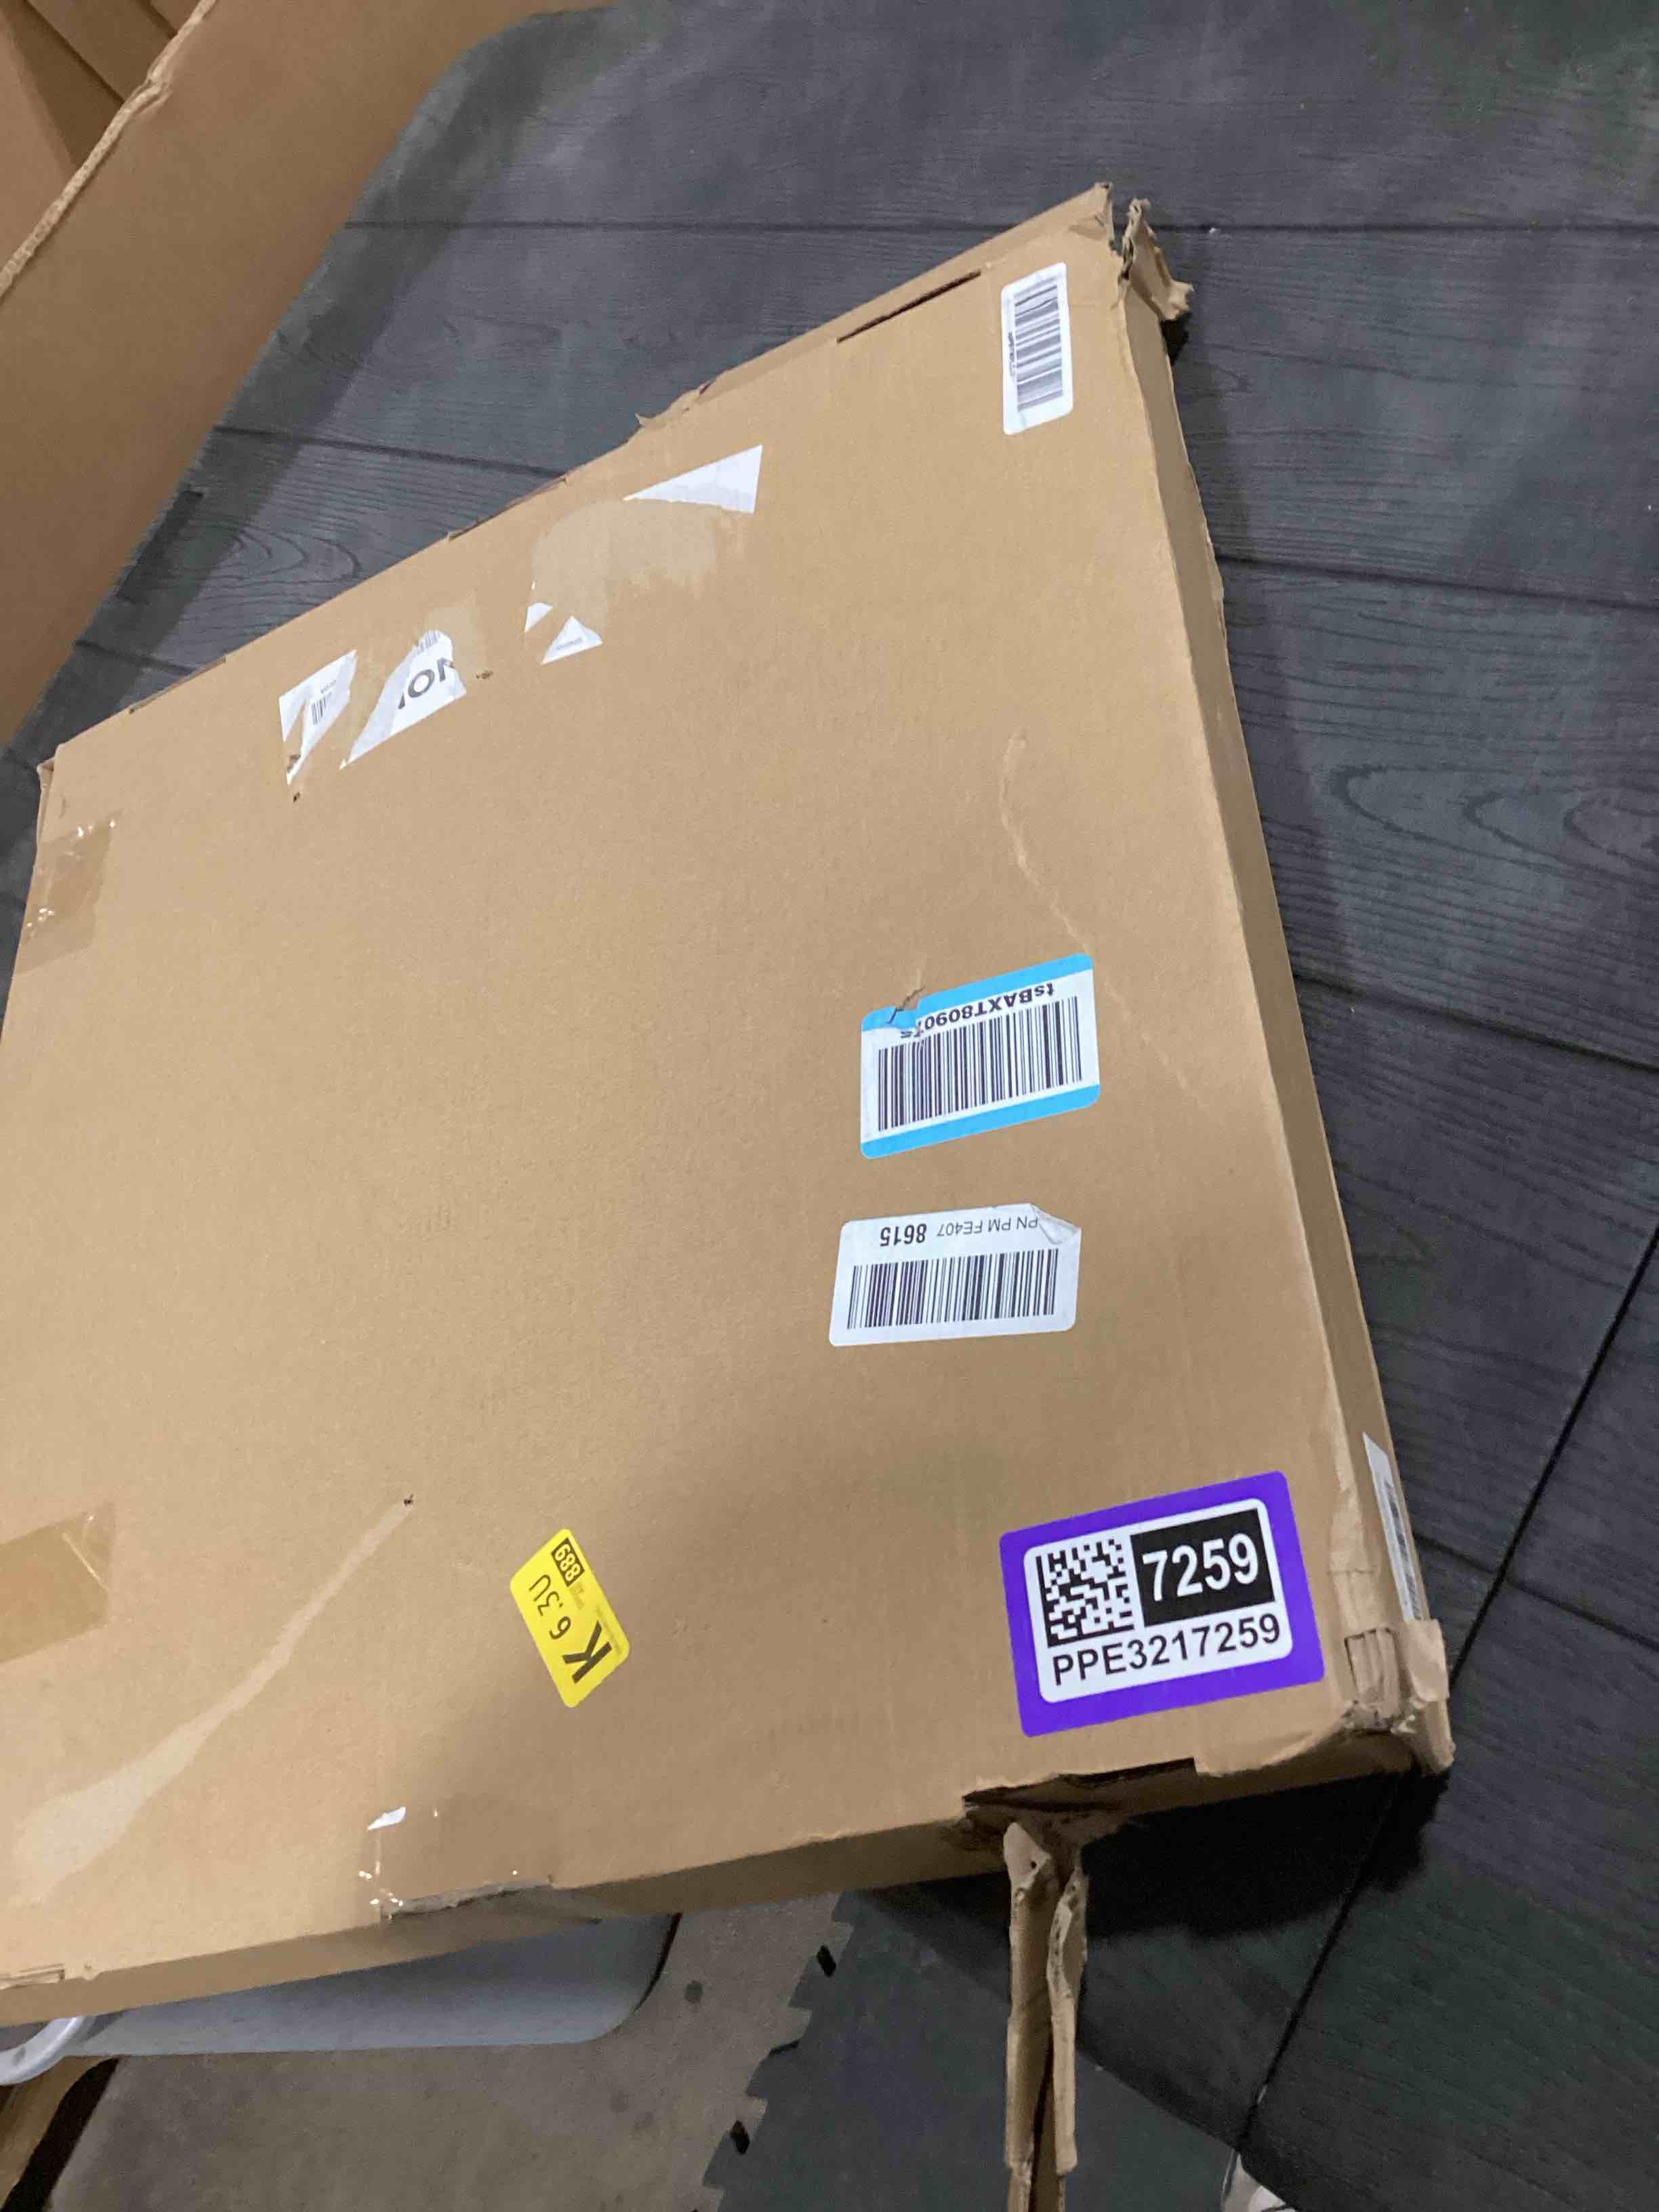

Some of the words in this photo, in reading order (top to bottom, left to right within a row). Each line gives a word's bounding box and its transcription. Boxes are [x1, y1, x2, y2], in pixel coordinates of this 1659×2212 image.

[880, 1223, 927, 1247] 8615
[937, 1221, 983, 1237] FE407
[987, 1217, 1011, 1232] PM
[1017, 1216, 1038, 1230] PN
[554, 1544, 581, 1582] 889
[1143, 1533, 1259, 1601] 7259
[562, 1620, 612, 1684] K
[1052, 1613, 1281, 1686] PPE3217259
